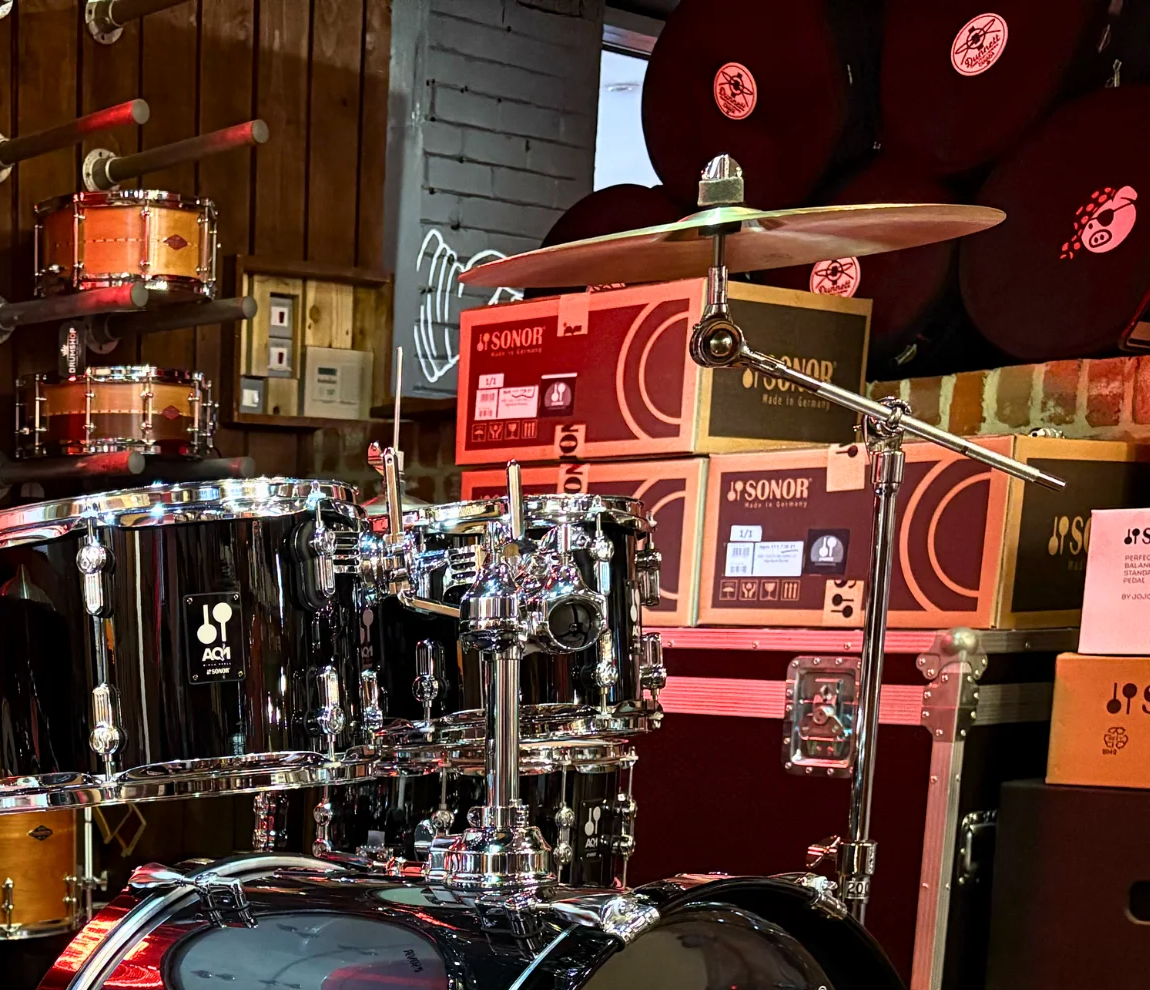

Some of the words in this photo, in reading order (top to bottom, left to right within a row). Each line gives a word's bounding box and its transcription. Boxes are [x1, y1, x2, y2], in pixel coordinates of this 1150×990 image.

[491, 326, 543, 350] SONOR
[762, 393, 782, 406] Made
[744, 478, 809, 501] SONOR
[739, 529, 754, 539] 1/1
[201, 646, 231, 662] AQ1
